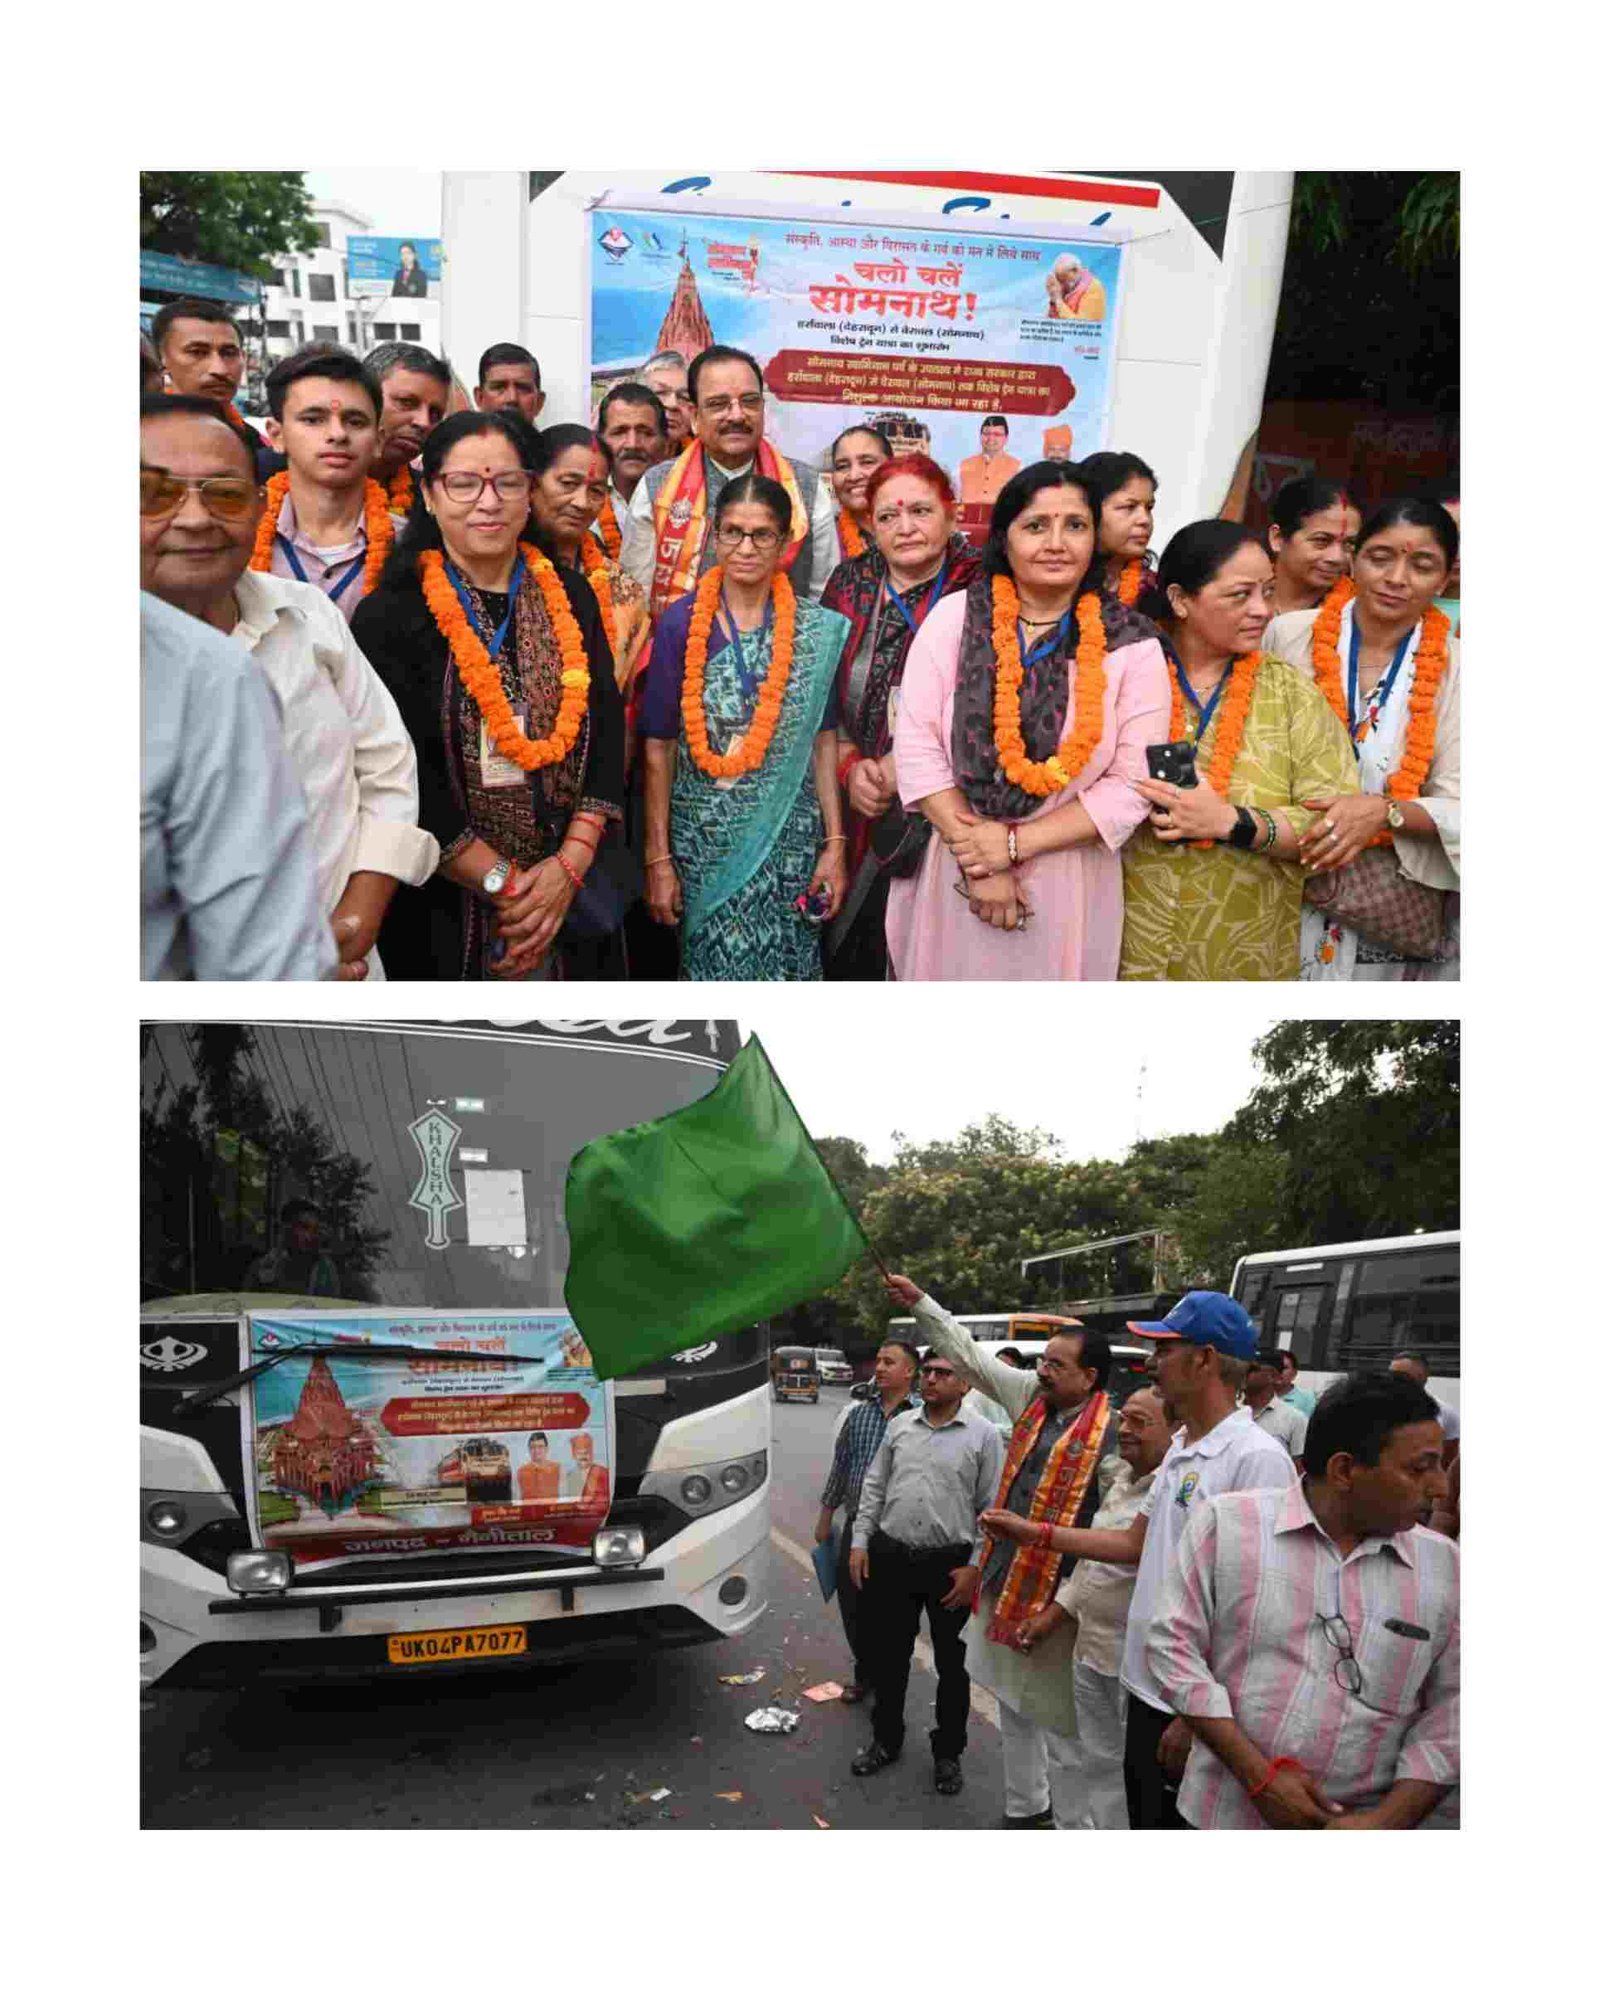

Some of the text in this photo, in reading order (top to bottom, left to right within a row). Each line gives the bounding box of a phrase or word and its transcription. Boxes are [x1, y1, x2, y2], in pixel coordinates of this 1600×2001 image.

[854, 257, 964, 288] चलो चलें
[809, 273, 978, 321] सोमनाथ!
[428, 1122, 443, 1205] KHALSHA
[400, 1630, 523, 1658] UK04PA7077
